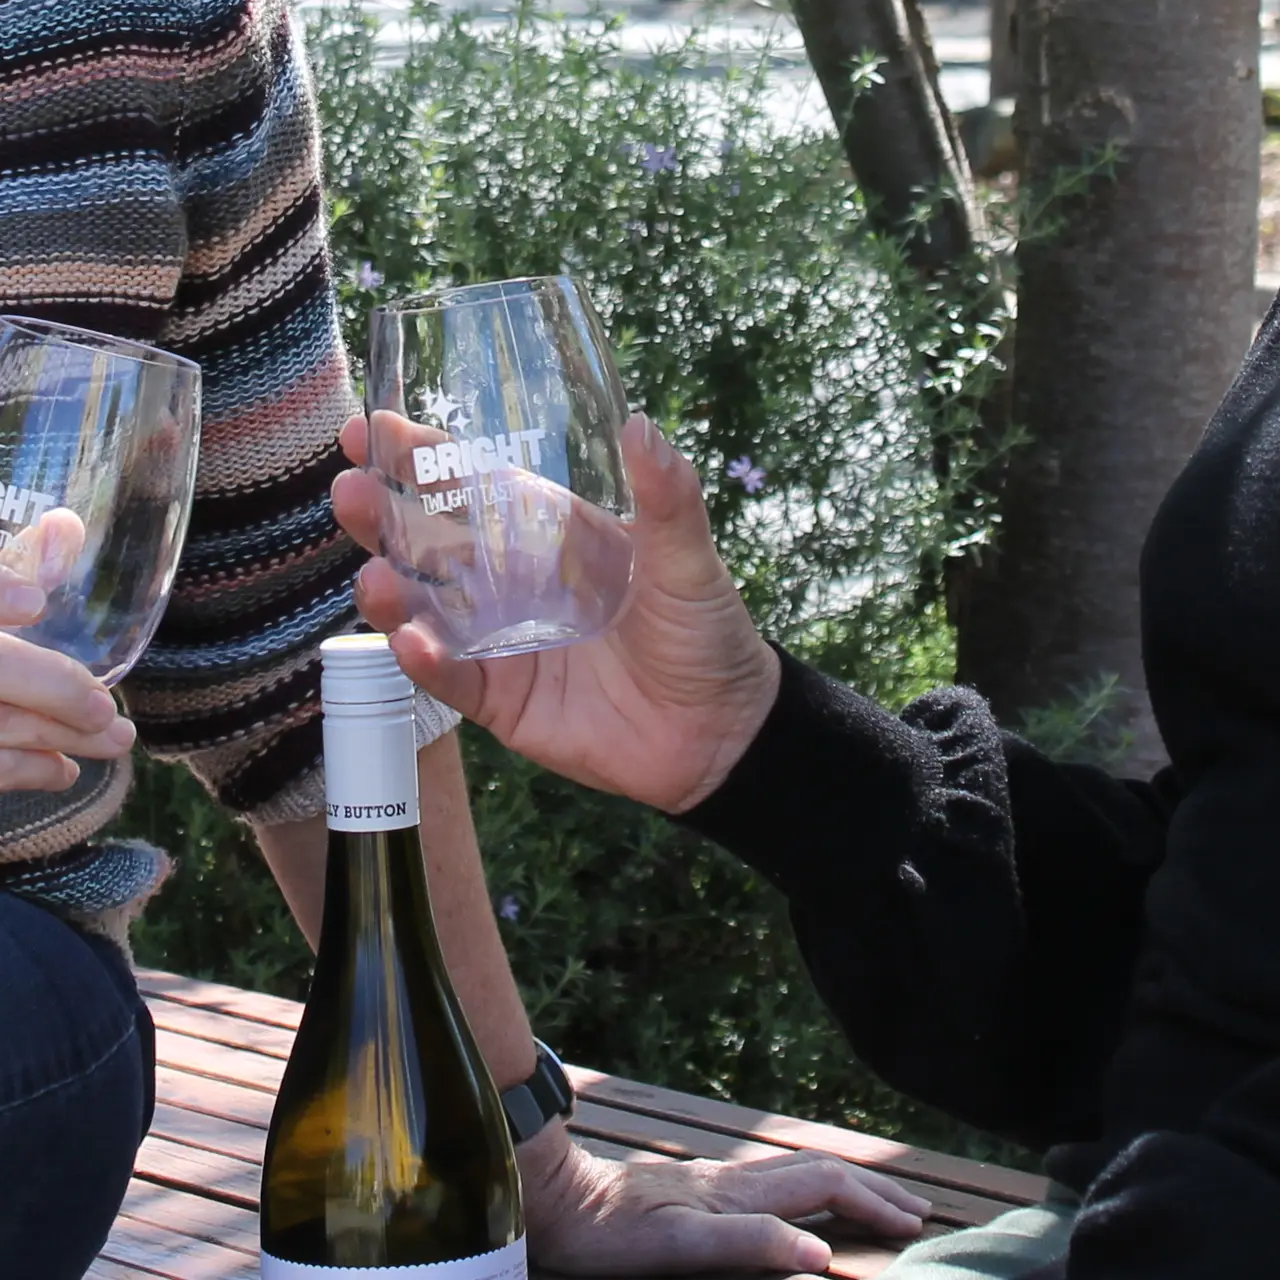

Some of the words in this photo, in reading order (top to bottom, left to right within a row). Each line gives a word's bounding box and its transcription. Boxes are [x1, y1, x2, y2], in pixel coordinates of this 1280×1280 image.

[413, 429, 545, 485] BRIGHT
[420, 488, 473, 516] TWILIGHT
[344, 802, 407, 819] BUTTON
